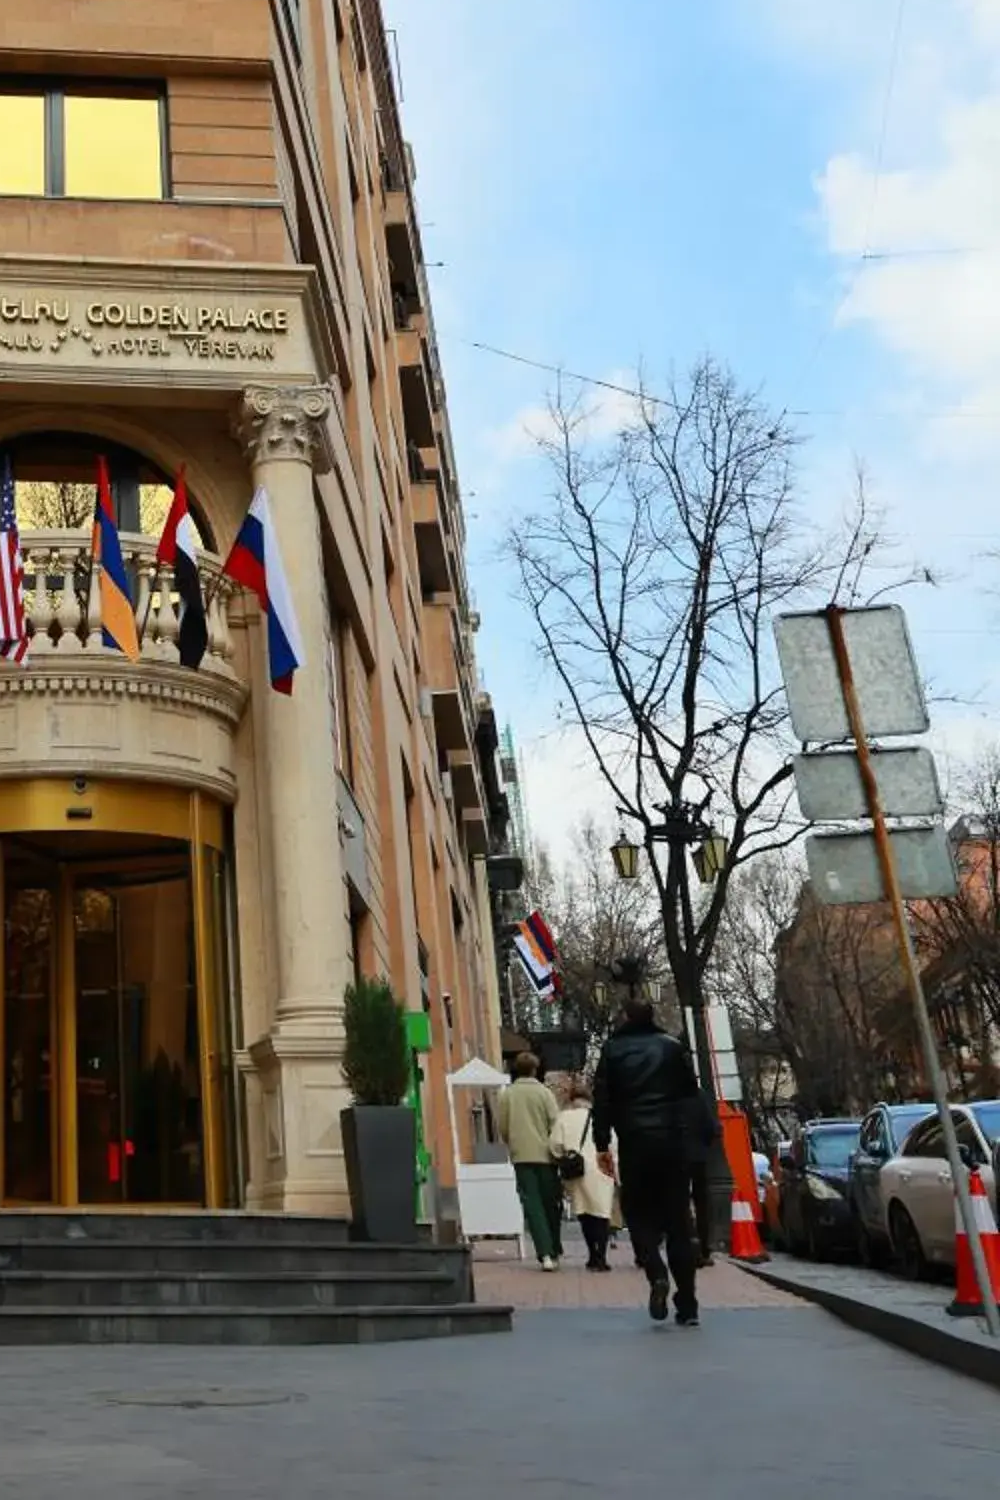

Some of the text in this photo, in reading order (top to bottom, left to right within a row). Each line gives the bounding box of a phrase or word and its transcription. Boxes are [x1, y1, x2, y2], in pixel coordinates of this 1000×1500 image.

[87, 302, 289, 330] GOLDEN PALACE
[108, 337, 275, 360] HOTEL YEREVAN
